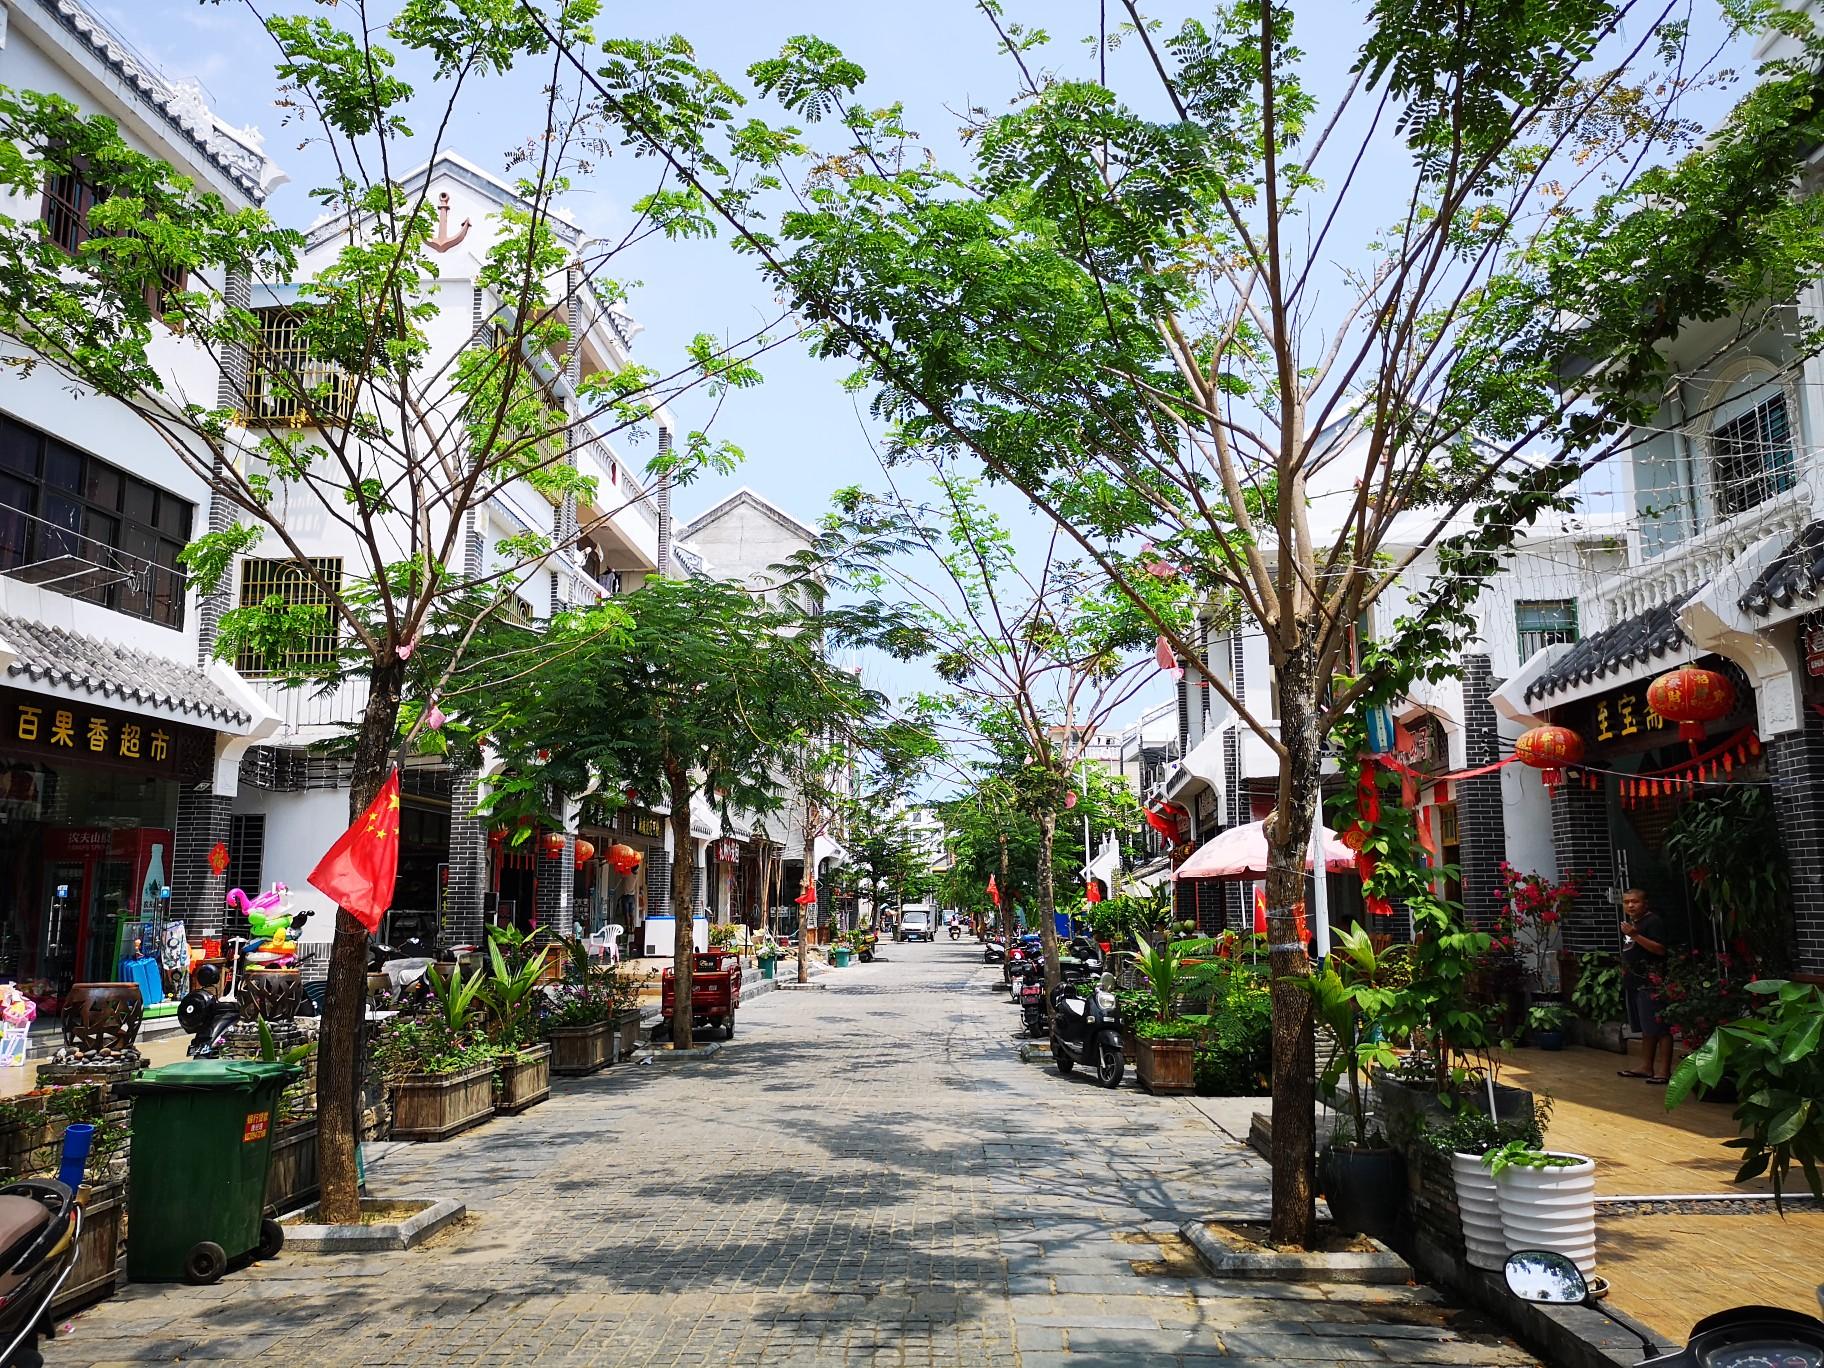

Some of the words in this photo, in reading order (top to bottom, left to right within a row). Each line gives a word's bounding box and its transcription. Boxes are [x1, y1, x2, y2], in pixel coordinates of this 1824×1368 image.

[18, 705, 170, 761] 百果香超市
